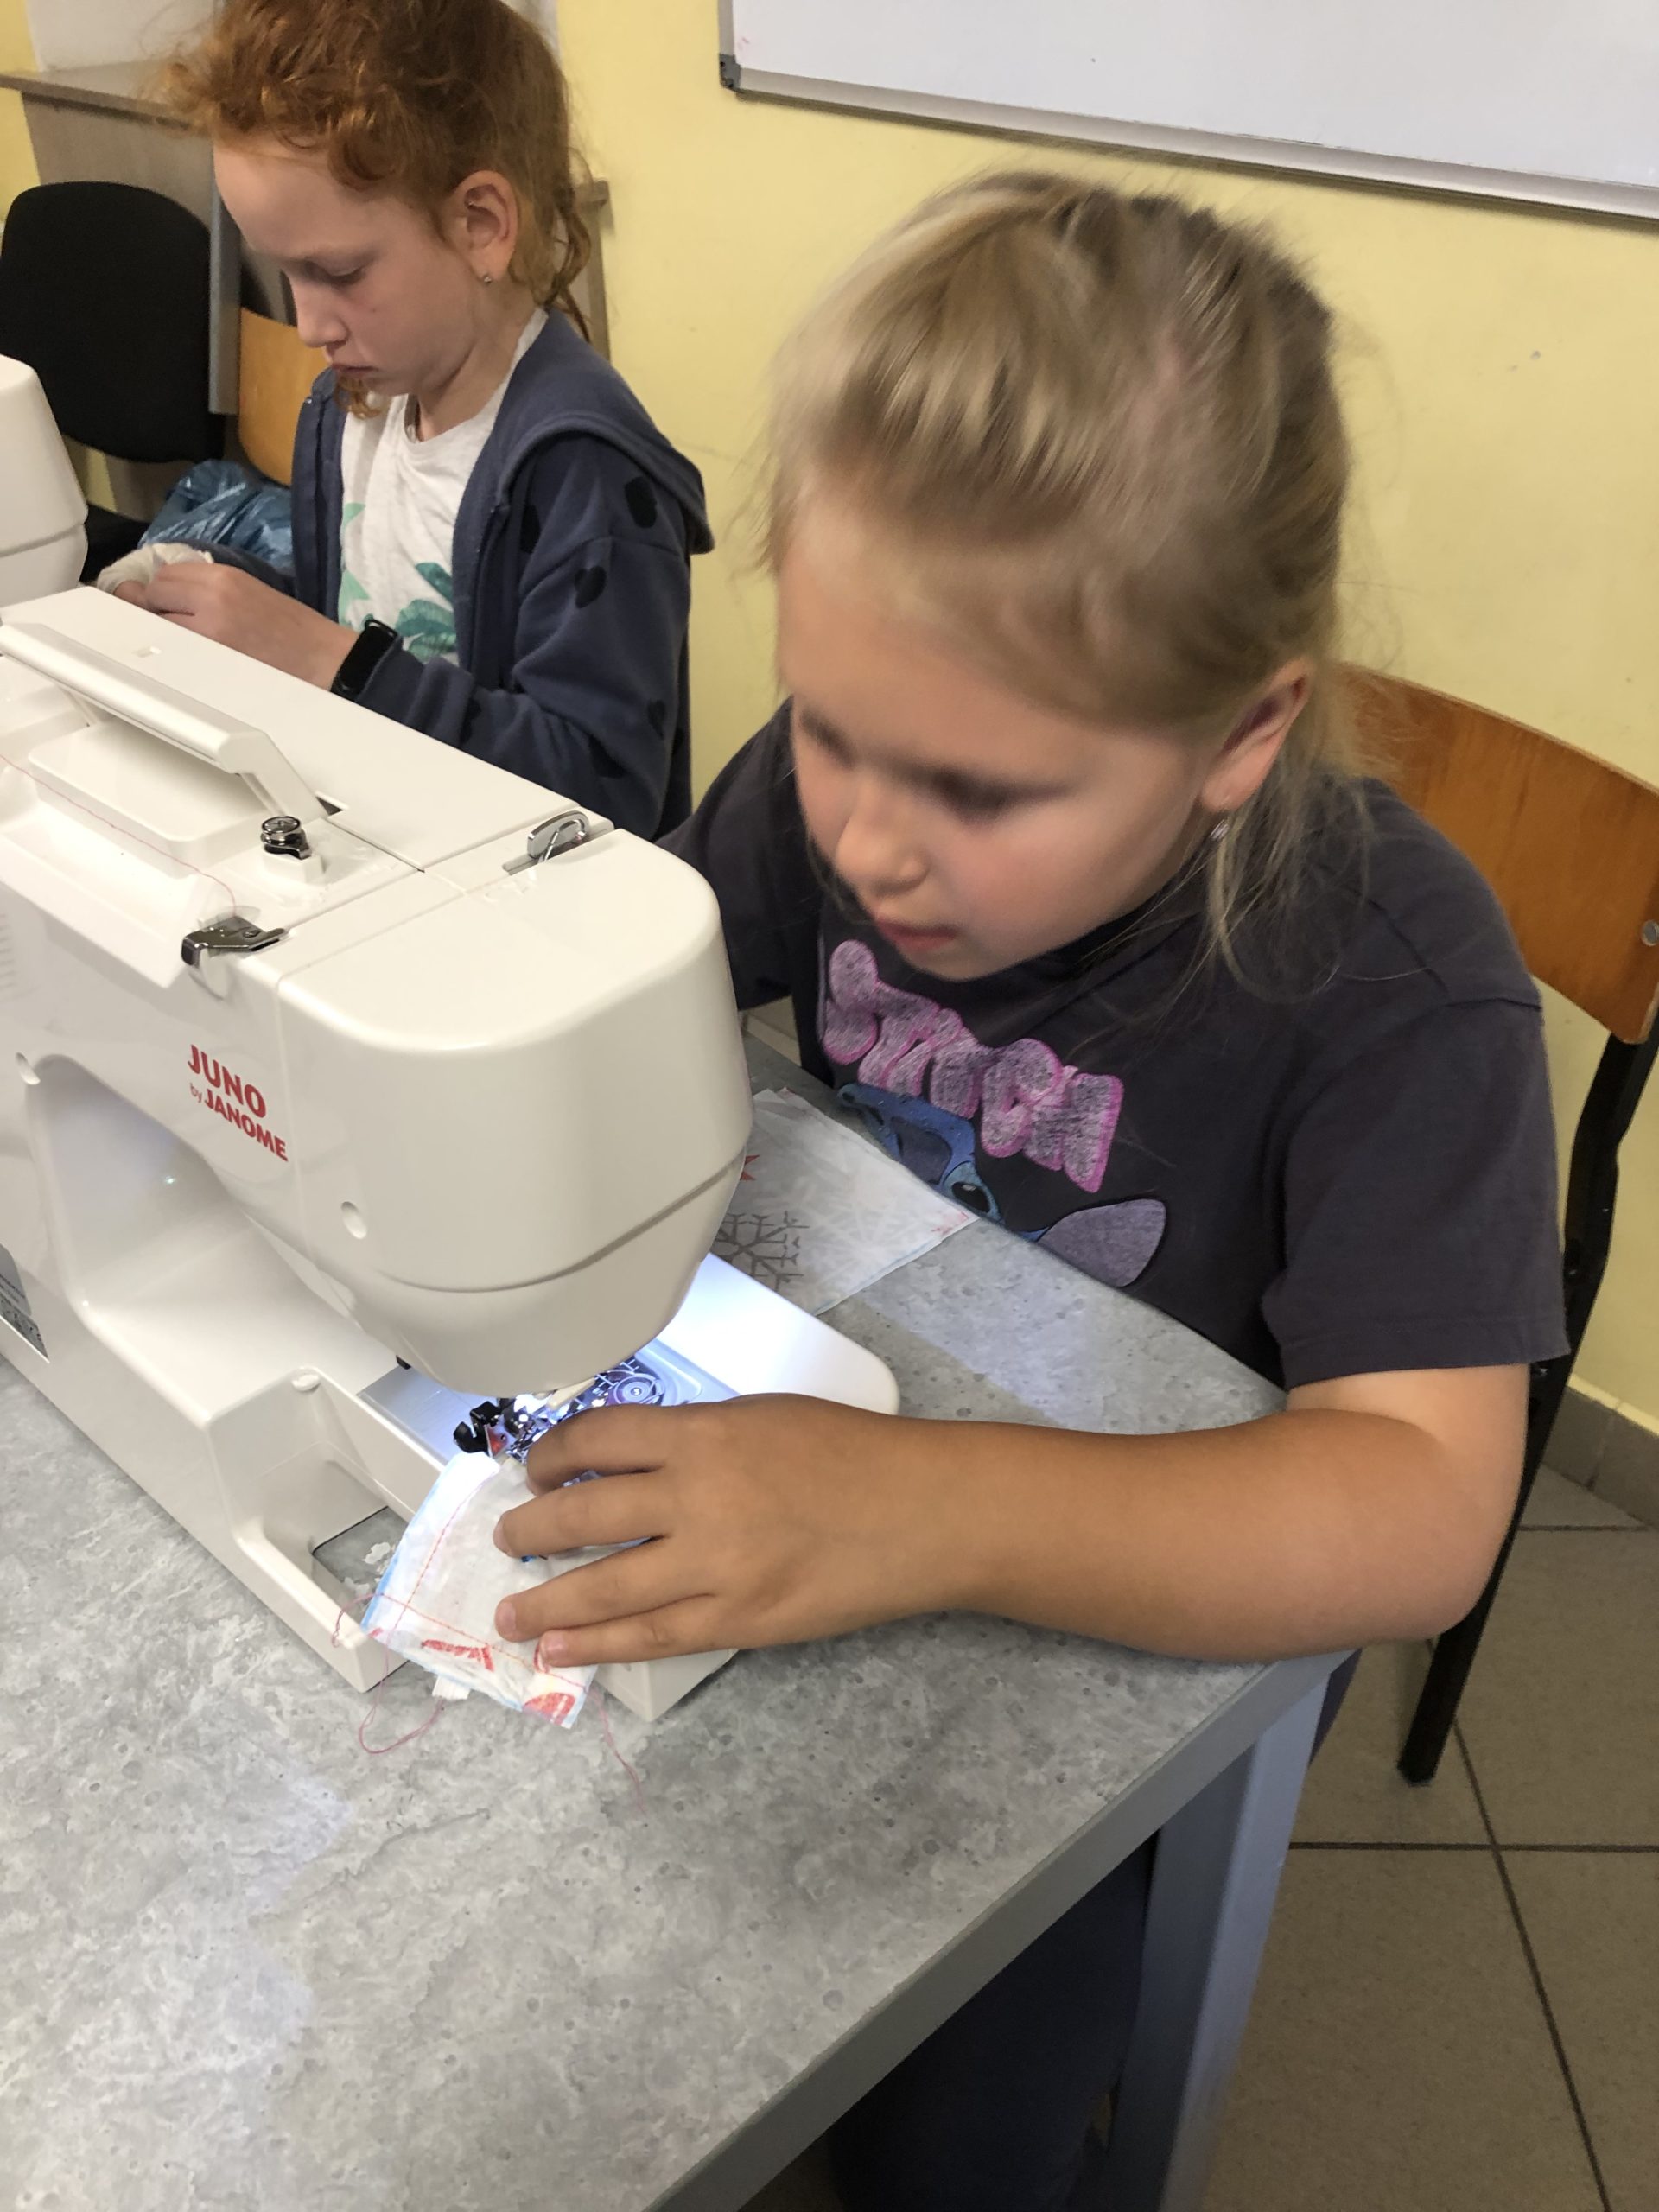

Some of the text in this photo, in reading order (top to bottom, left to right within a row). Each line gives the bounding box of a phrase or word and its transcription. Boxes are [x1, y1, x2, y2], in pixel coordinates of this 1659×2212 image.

[188, 1044, 266, 1118] JUNO
[190, 1082, 289, 1162] by JANOME
